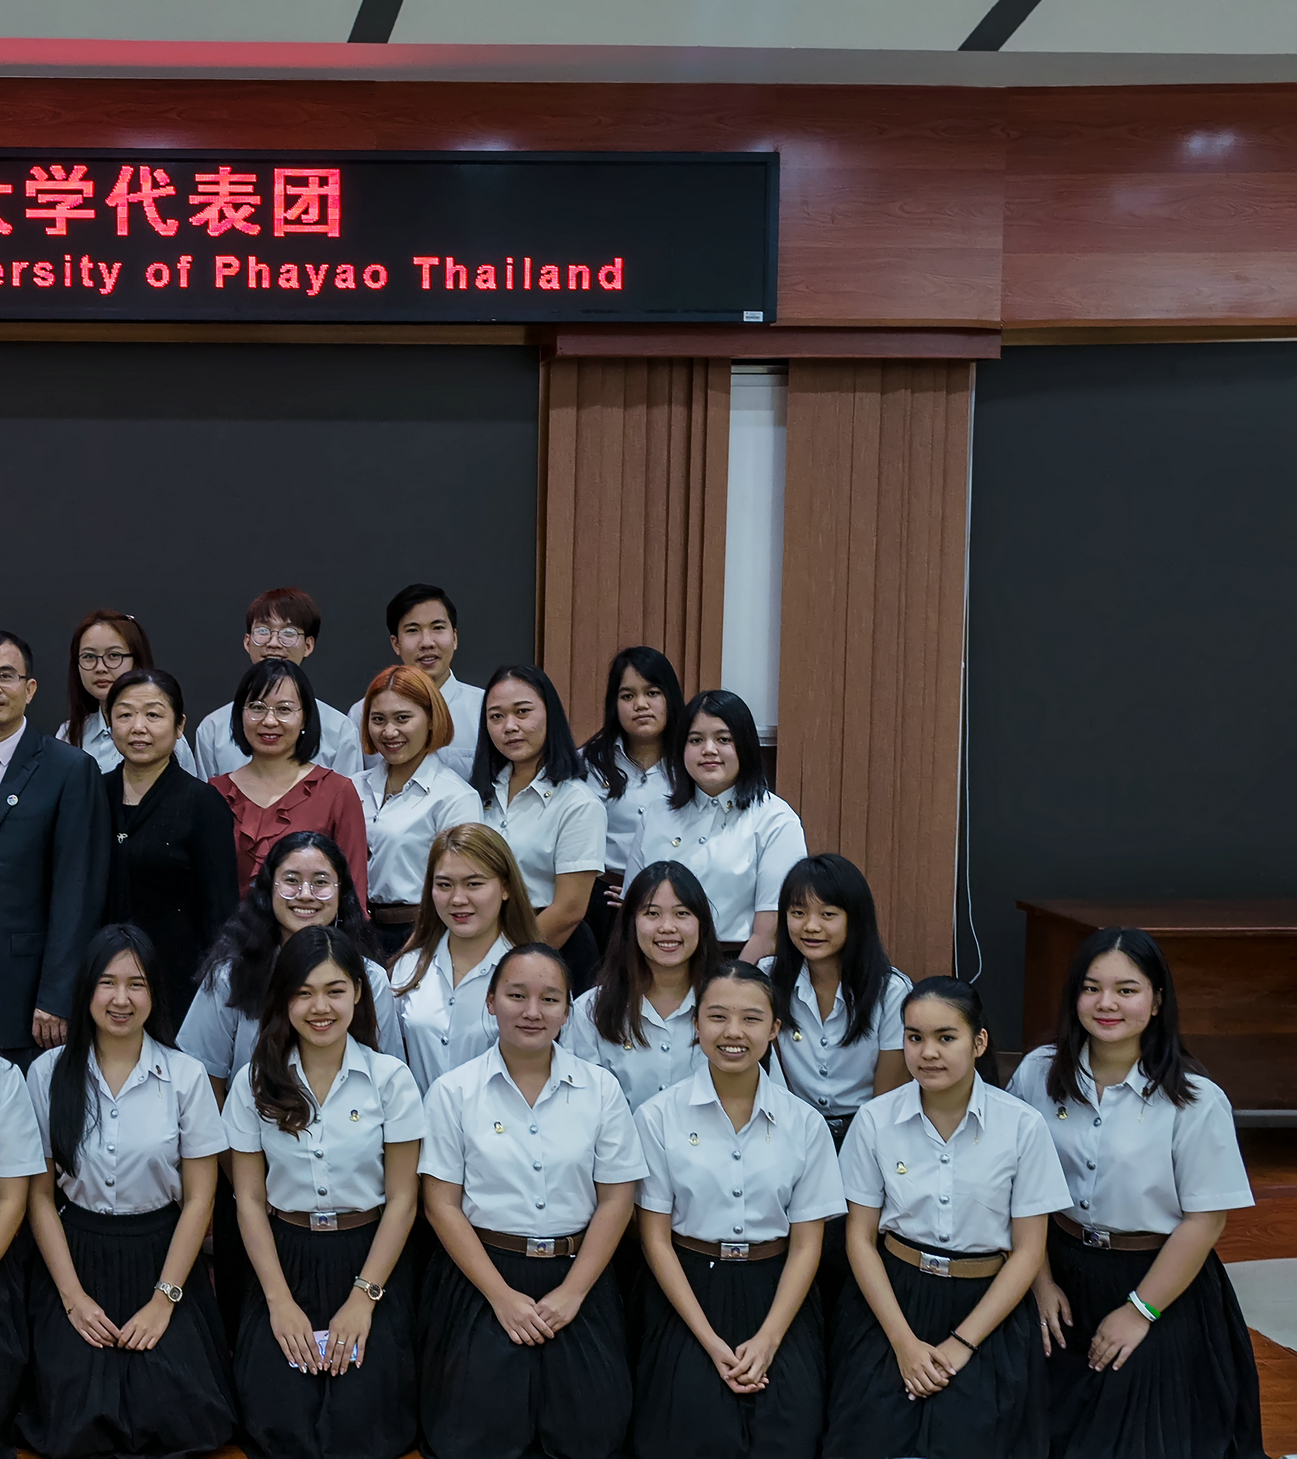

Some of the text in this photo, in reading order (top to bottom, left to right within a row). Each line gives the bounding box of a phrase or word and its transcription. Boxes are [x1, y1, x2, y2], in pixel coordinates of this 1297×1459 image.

[145, 255, 194, 289] of
[215, 255, 389, 297] Phayao
[413, 256, 624, 291] Thailand
